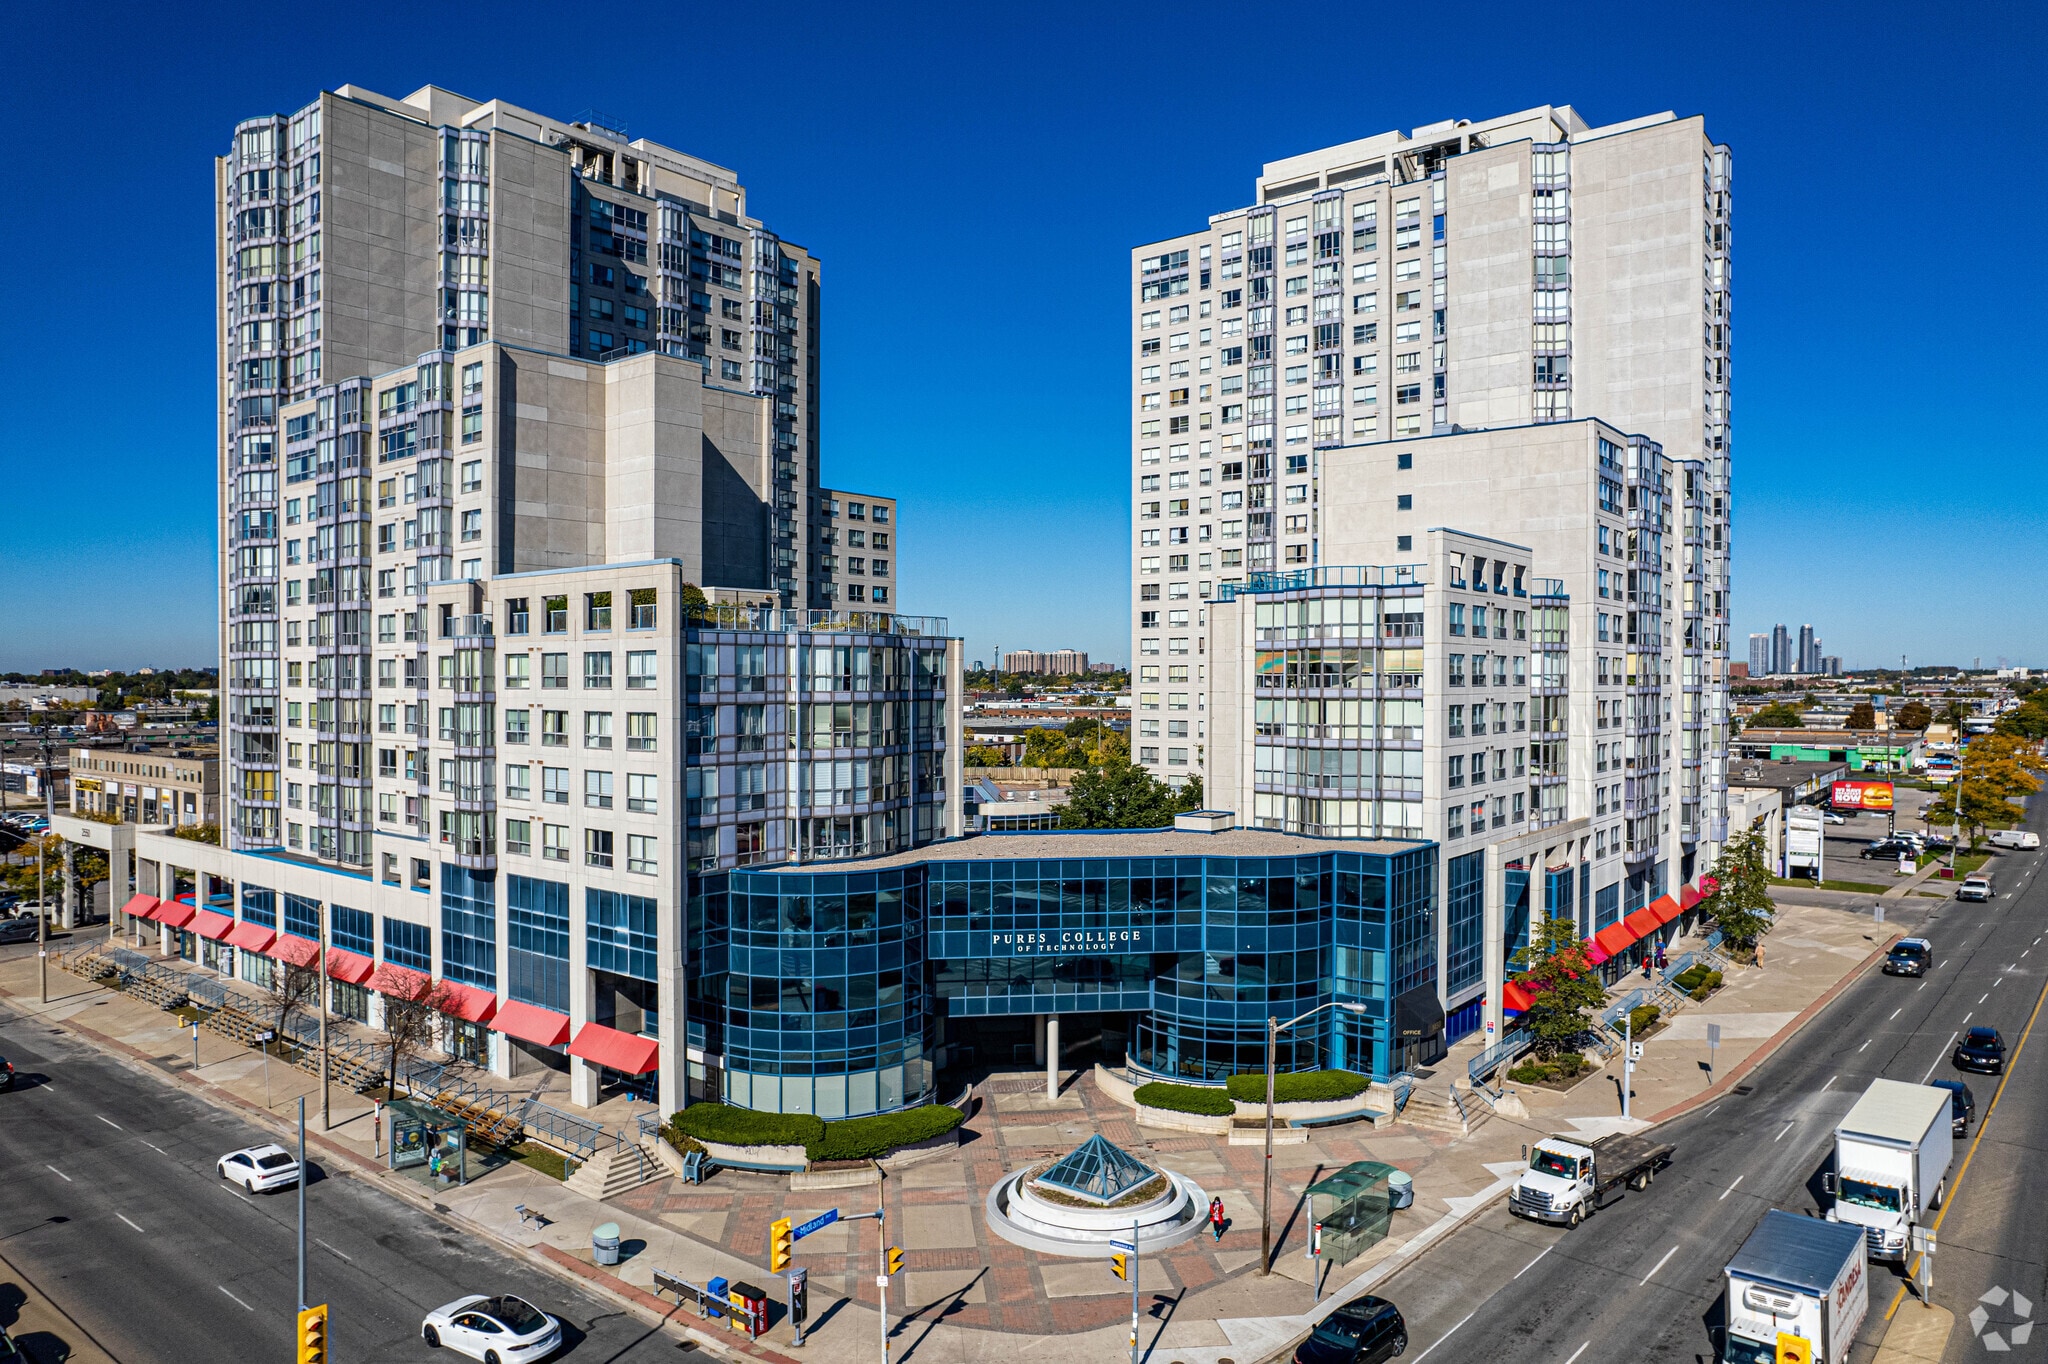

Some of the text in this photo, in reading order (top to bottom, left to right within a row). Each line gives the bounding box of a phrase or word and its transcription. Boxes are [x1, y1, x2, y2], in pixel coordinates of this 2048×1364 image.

[1835, 794, 1862, 802] NOW
[992, 931, 1141, 944] PURES COLLEGE
[1038, 943, 1115, 951] TECHNOLOGY
[799, 1216, 825, 1235] Midland
